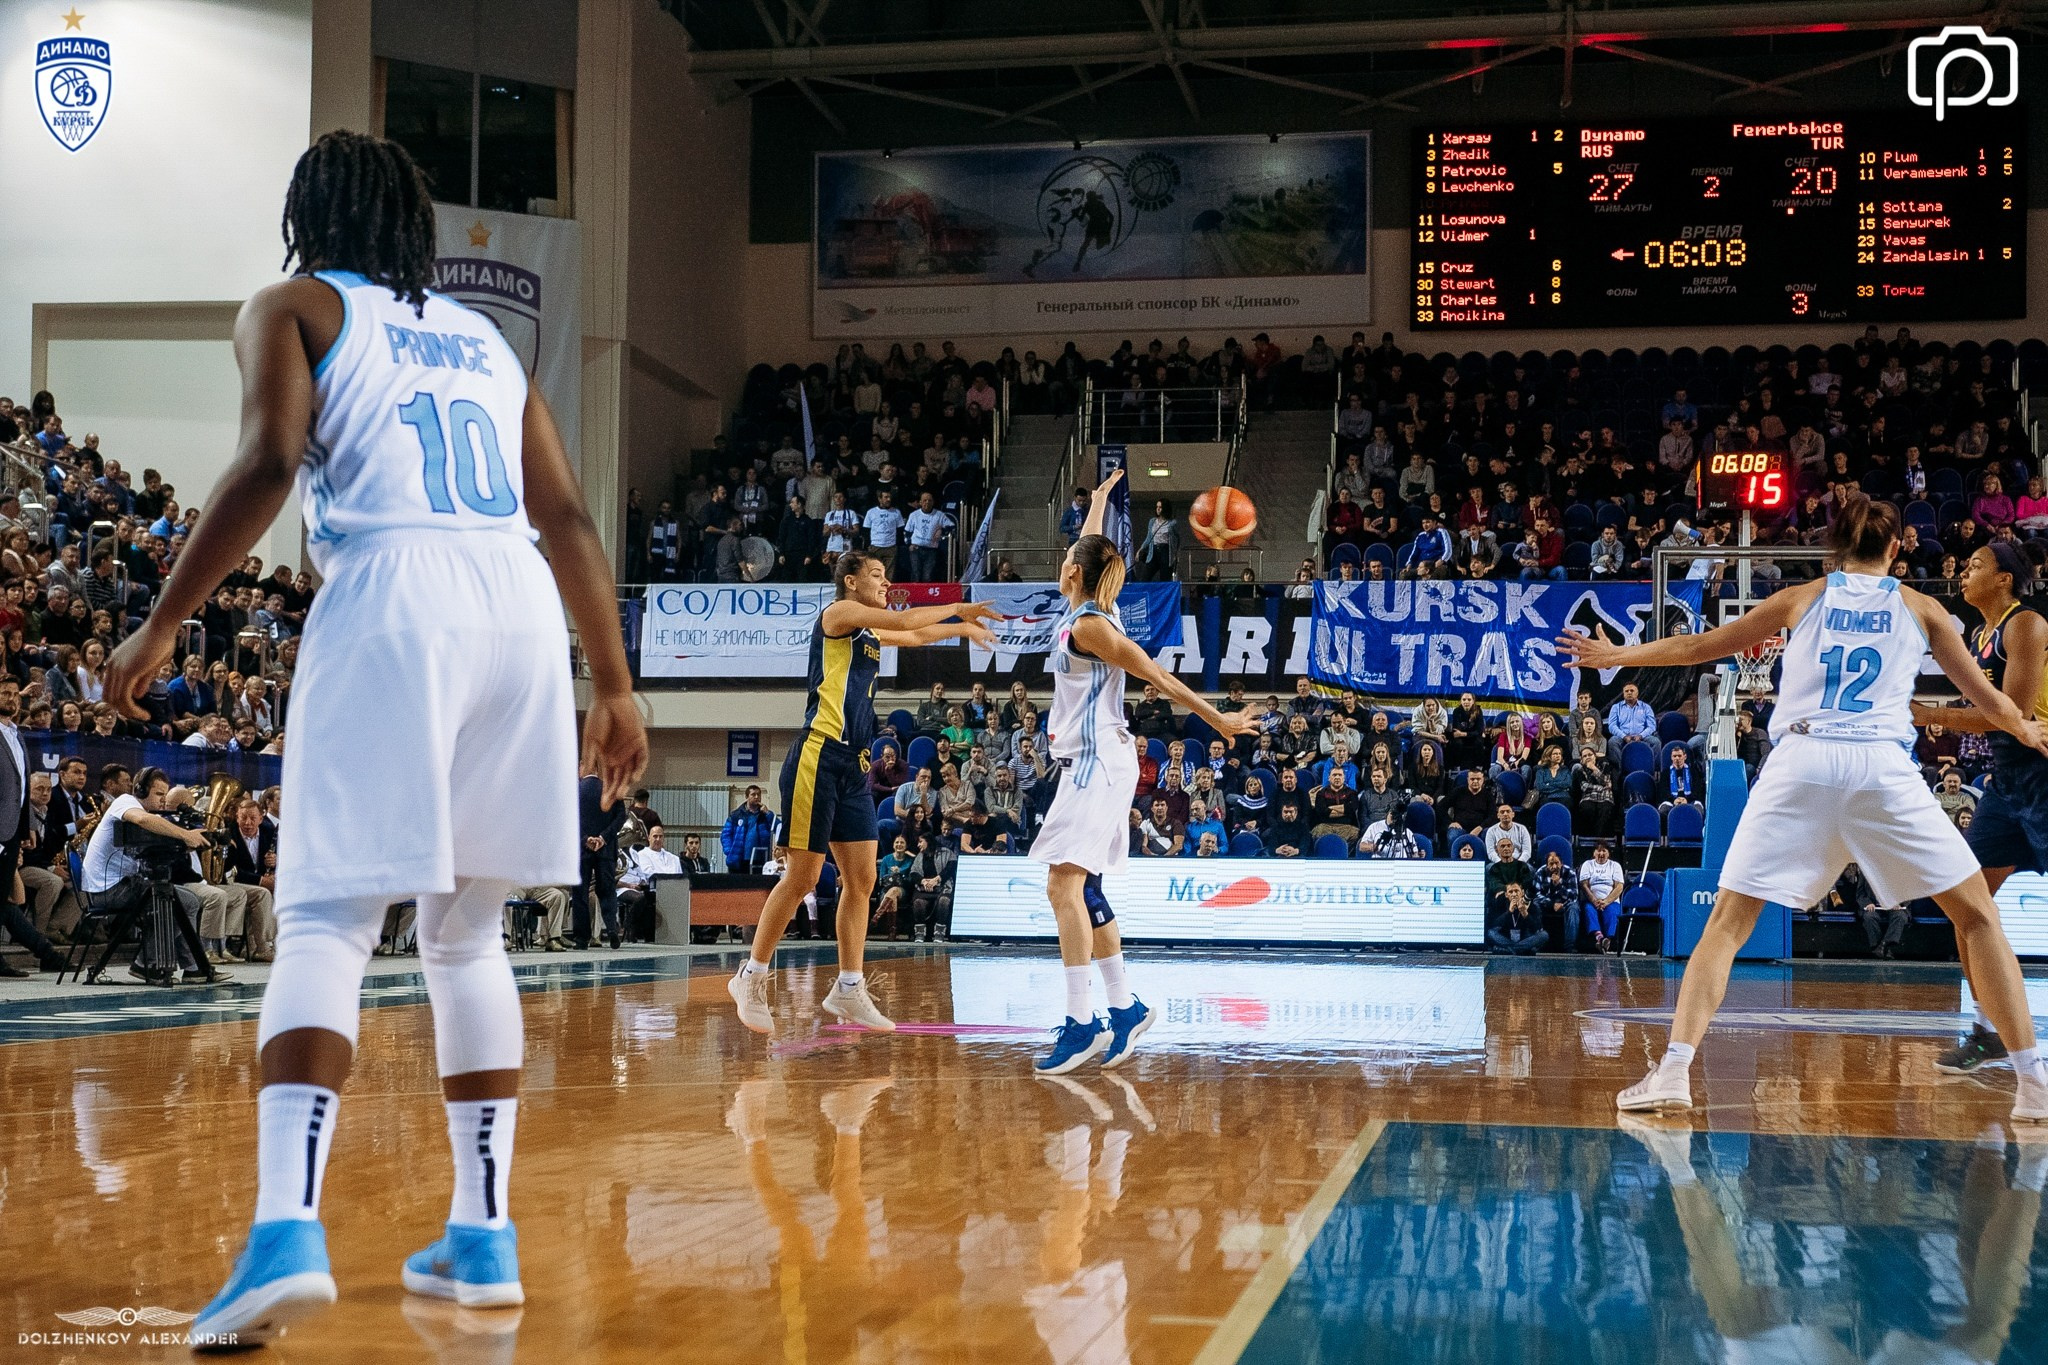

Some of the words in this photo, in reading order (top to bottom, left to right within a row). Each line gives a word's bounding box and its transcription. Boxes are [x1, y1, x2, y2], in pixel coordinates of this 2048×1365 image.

[1429, 134, 1434, 145] 1
[1443, 133, 1491, 144] Xargay
[1532, 131, 1537, 142] 1
[1554, 130, 1563, 141] 2
[1581, 130, 1645, 142] Dynamo
[1733, 122, 1843, 139] Fenerbahce
[1811, 136, 1844, 150] TUR
[1427, 150, 1435, 161] 3
[1443, 148, 1489, 160] Zhedik
[1581, 144, 1613, 158] RUS
[1860, 152, 1875, 164] 10
[1884, 152, 1917, 163] Plum
[1980, 149, 1984, 159] 1
[2004, 147, 2012, 158] 2
[1608, 163, 1640, 173] СЧЕТ
[1785, 158, 1818, 167] СЧЕТ
[1427, 166, 1435, 177] 5
[1443, 165, 1506, 177] Petrovic
[1554, 163, 1562, 174] 5
[1691, 167, 1733, 175] ПЕРИОД
[1860, 168, 1874, 180] 11
[1884, 166, 1967, 179] Verameyenk
[1978, 165, 1986, 176] 3
[2004, 164, 2012, 175] 5
[1427, 182, 1435, 193] 9
[1443, 180, 1514, 192] Levchenko
[1589, 174, 1633, 201] 27
[1704, 176, 1719, 197] 2
[1792, 167, 1836, 194] 20
[1594, 203, 1652, 213] ТАЙМ-АУТЫ
[1859, 202, 1874, 214] 14
[1883, 201, 1942, 213] Sottana
[2003, 198, 2011, 209] 2
[1419, 215, 1433, 226] 11
[1442, 214, 1506, 225] Logunova
[1860, 218, 1875, 230] 15
[1884, 216, 1950, 229] Senyurek
[1419, 231, 1434, 242] 12
[1441, 230, 1489, 241] Vidmer
[1530, 229, 1535, 240] 1
[1681, 225, 1743, 239] ВРЕМЯ
[1858, 235, 1875, 247] 23
[1883, 235, 1925, 246] Yavas
[1645, 239, 1746, 268] 06:08
[1858, 252, 1875, 263] 24
[1883, 249, 1968, 262] Zandalasin
[1979, 249, 1984, 259] 1
[2003, 248, 2011, 259] 5
[1419, 262, 1434, 273] 15
[1441, 262, 1473, 273] Cruz
[1553, 260, 1561, 271] 6
[1417, 279, 1433, 290] 30
[1441, 278, 1495, 290] Stewart
[1552, 277, 1560, 288] 8
[1693, 277, 1728, 285] ВРЕМЯ
[1785, 284, 1816, 292] ФОЛЫ
[1606, 288, 1637, 296] ФОЛЫ
[1682, 286, 1737, 295] ТАЙМ-АУТА
[1857, 285, 1873, 296] 33
[1883, 285, 1924, 296] Topuz
[1036, 298, 1134, 315] Генеральный
[1138, 298, 1197, 312] спонсор
[1201, 297, 1221, 309] БК
[1225, 295, 1300, 311] «Динамо»
[1417, 295, 1432, 306] 31
[1441, 294, 1496, 305] Charles
[1530, 293, 1535, 304] 1
[1552, 292, 1561, 303] 6
[1792, 293, 1808, 314] 3
[1417, 311, 1433, 321] 33
[1441, 310, 1504, 321] Anoikina
[384, 323, 492, 377] PRINCE
[398, 391, 518, 517] 10
[1748, 473, 1782, 505] 15
[1323, 579, 1550, 629] KURSK
[1824, 608, 1892, 634] VIDMER
[656, 629, 669, 645] НЕ
[673, 629, 708, 645] МОЖЕМ
[711, 629, 770, 646] ЗАМОЛЧАТЬ
[775, 629, 783, 646] С
[996, 634, 1053, 645] ЕПАРД
[1314, 618, 1558, 693] ULTRAS
[1819, 646, 1882, 714] 12
